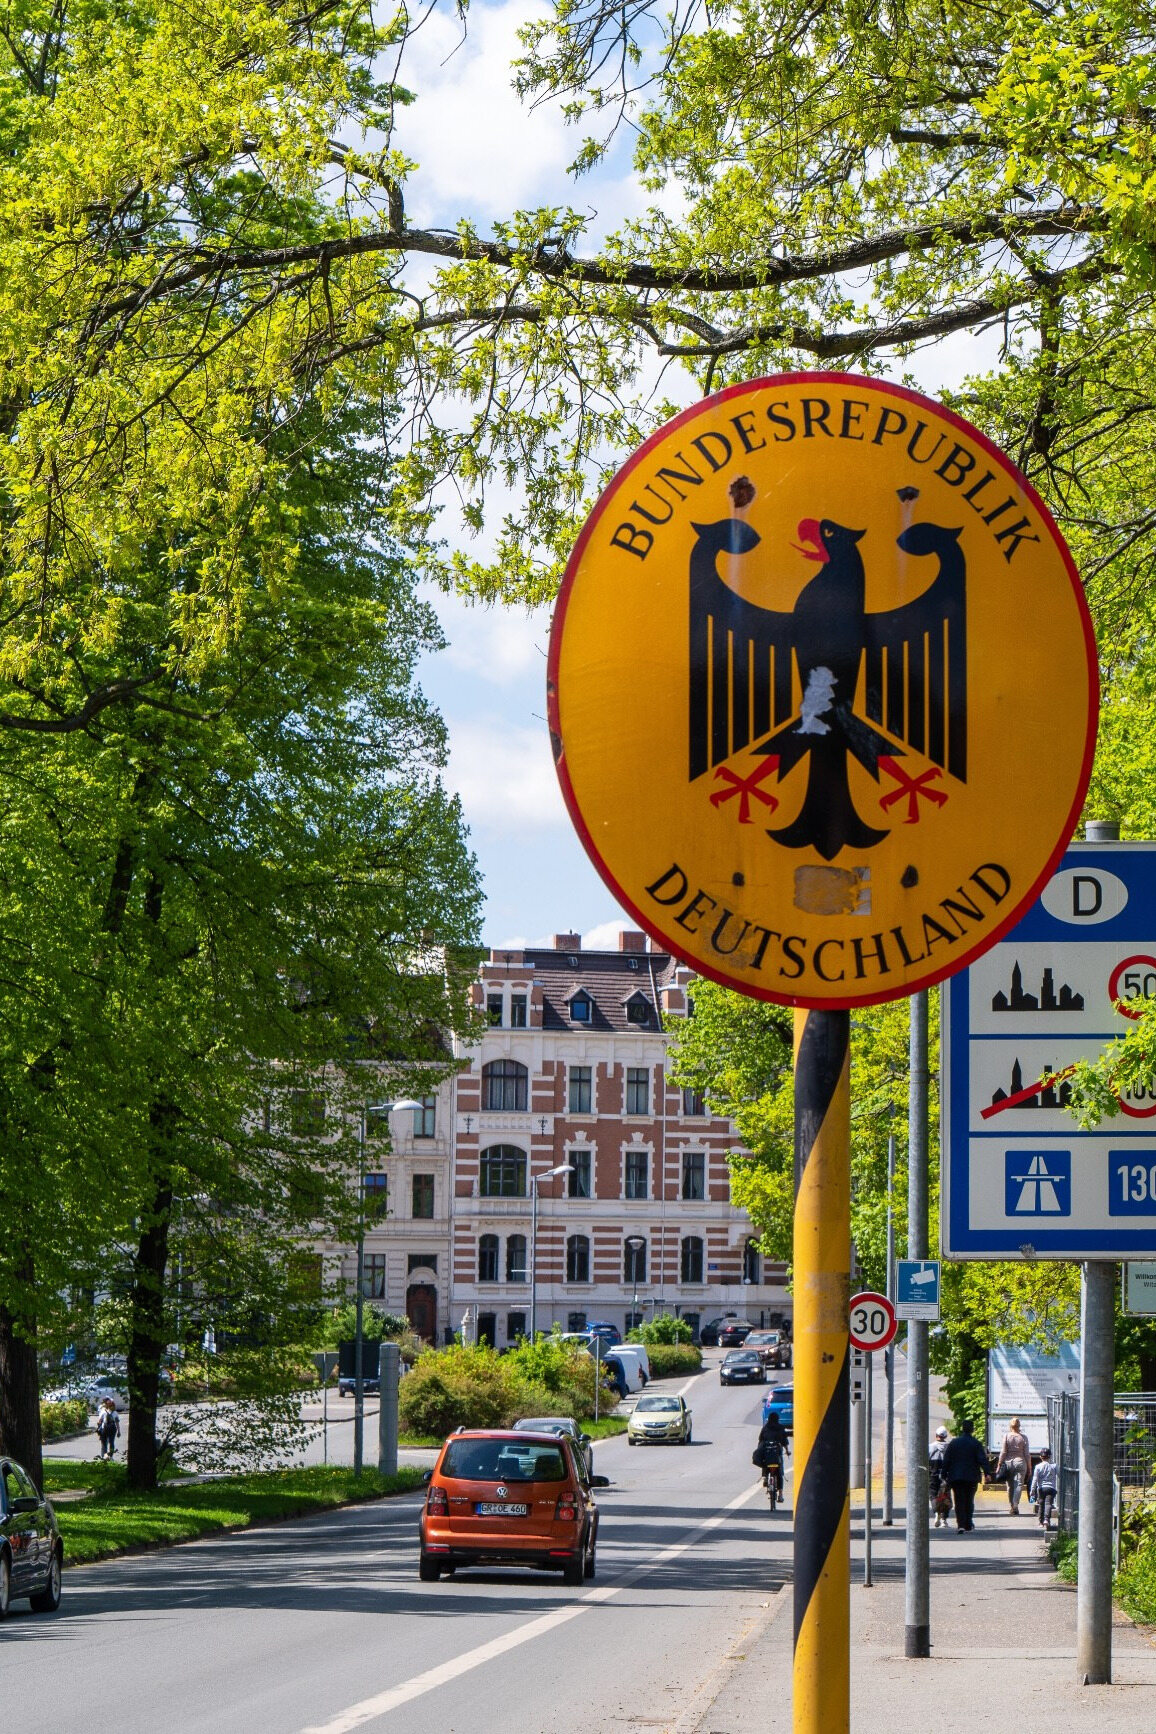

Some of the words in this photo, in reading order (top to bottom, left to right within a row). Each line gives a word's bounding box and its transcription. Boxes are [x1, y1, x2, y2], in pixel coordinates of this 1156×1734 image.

[609, 399, 1041, 564] BUNDESREPUBLIK
[644, 862, 1012, 981] DEUTSCHLAND
[1072, 875, 1103, 917] D
[853, 1309, 885, 1335] 30
